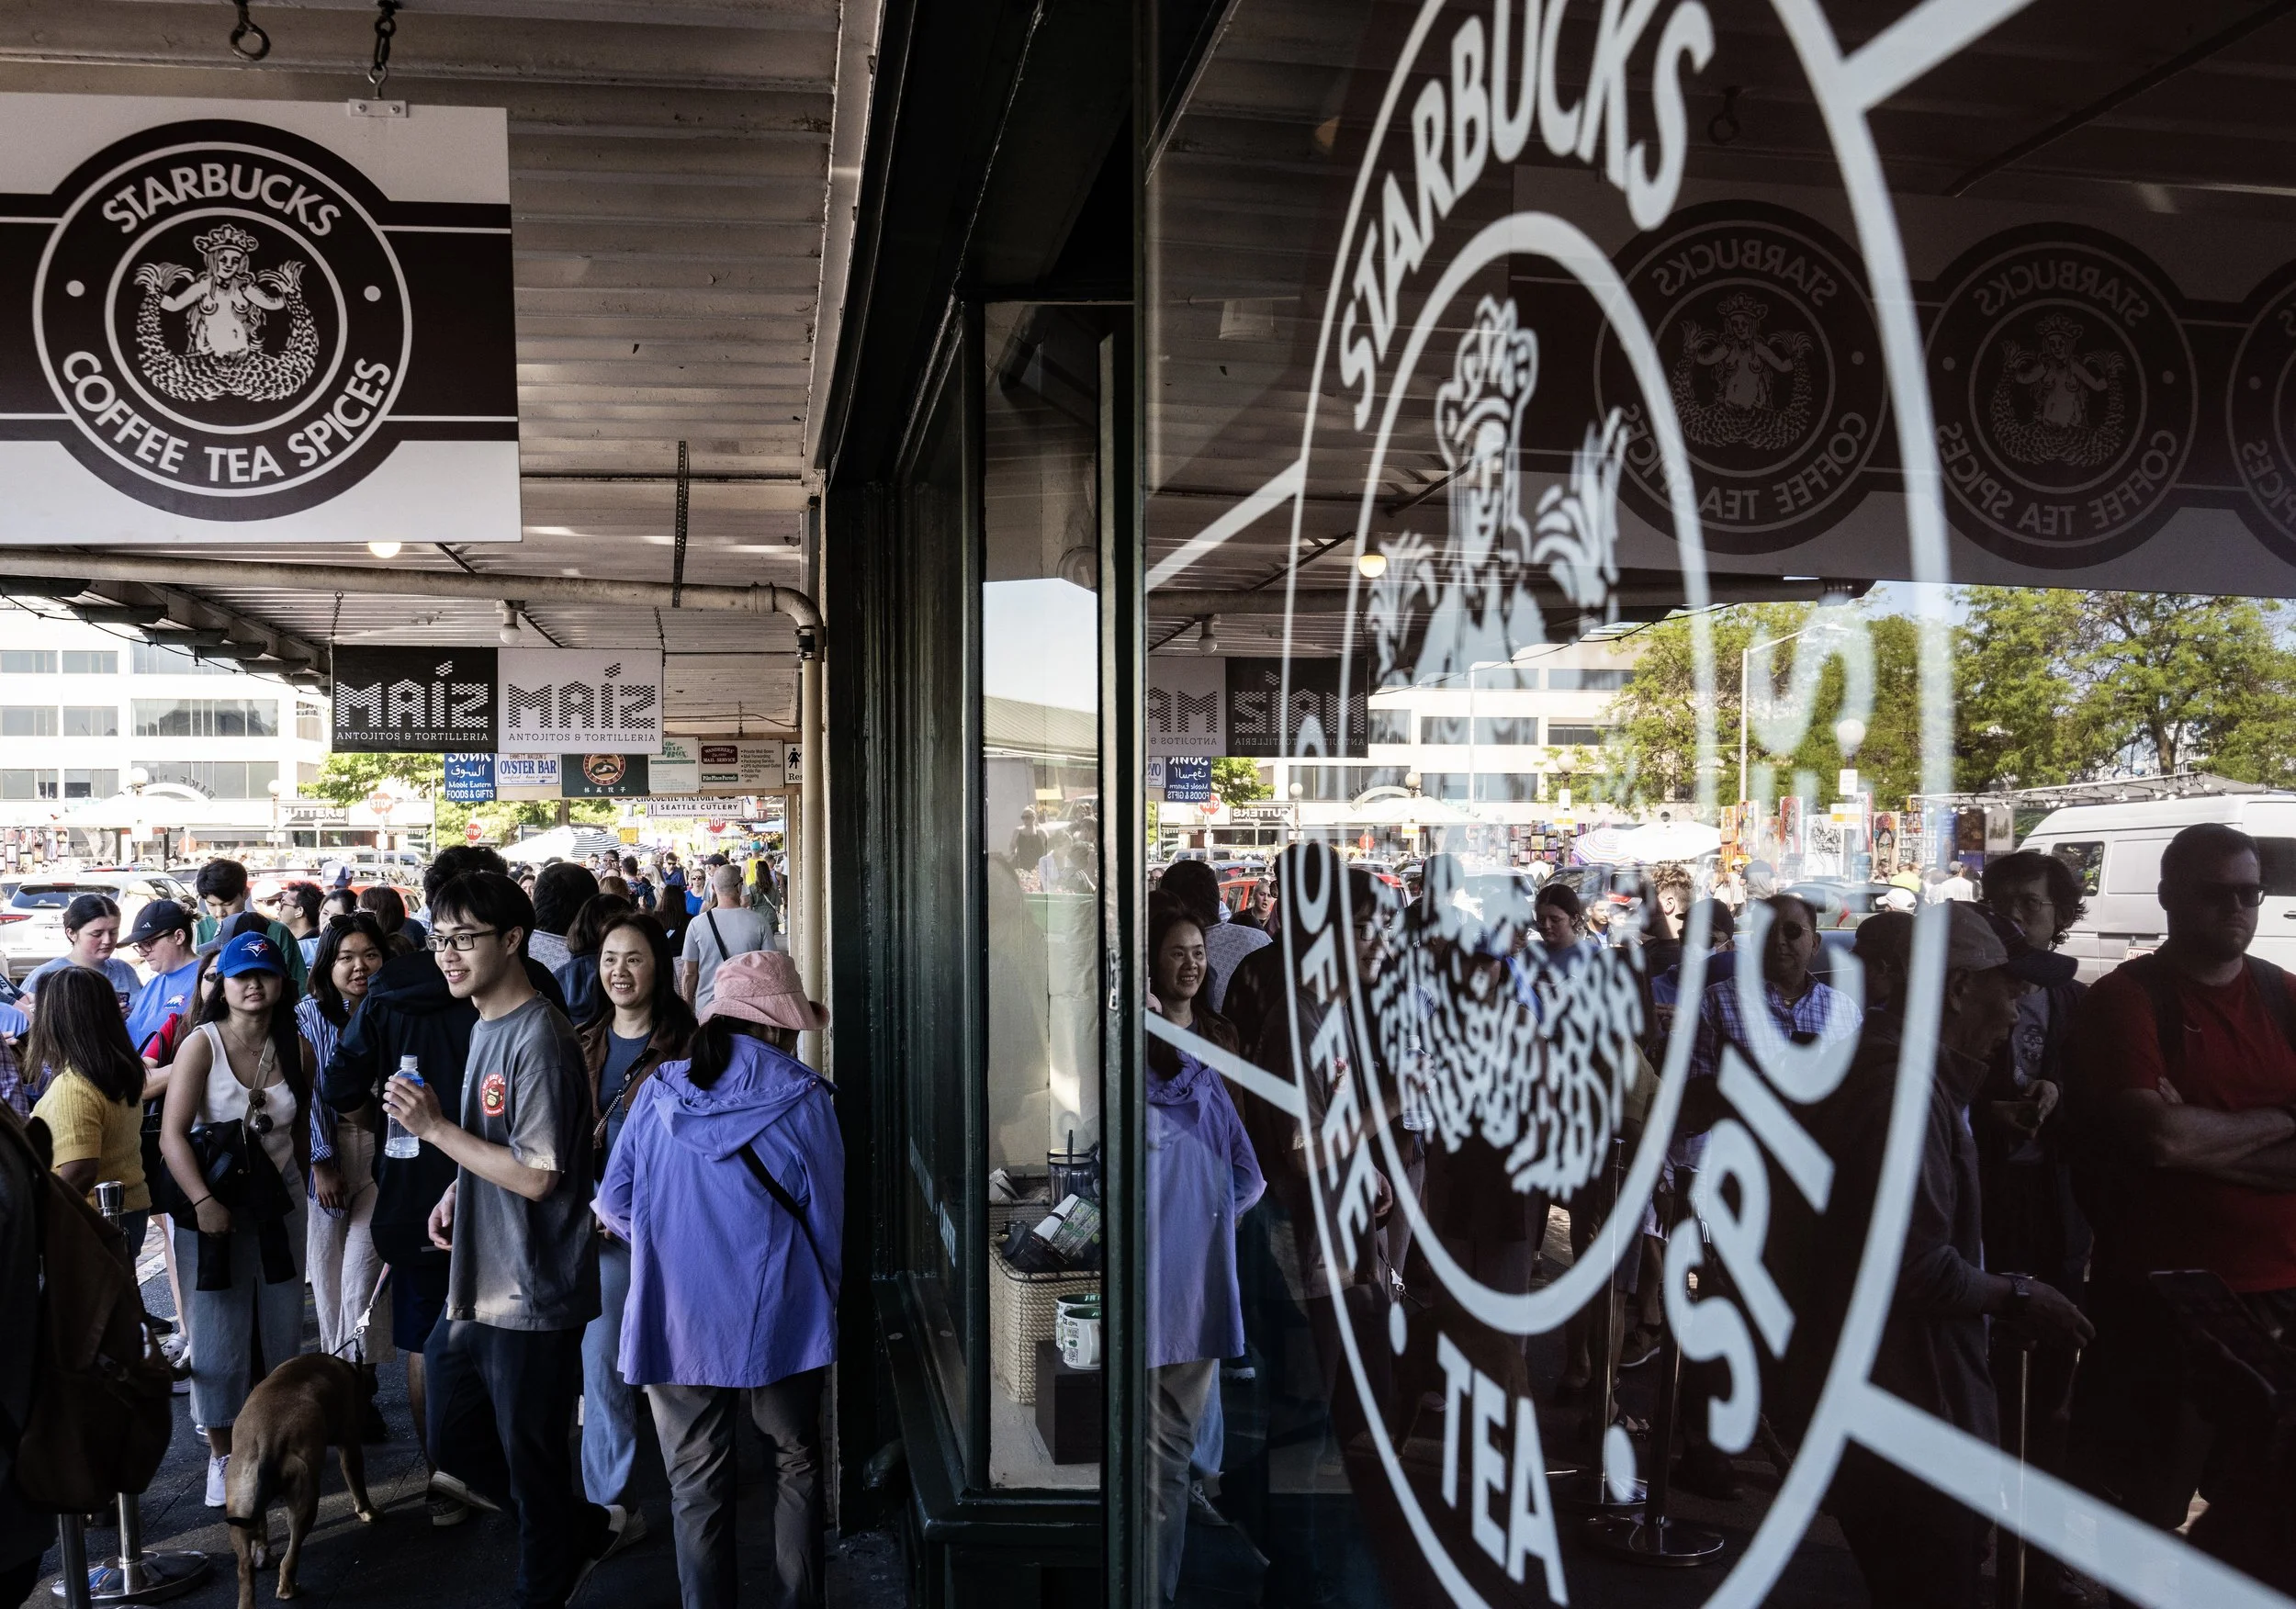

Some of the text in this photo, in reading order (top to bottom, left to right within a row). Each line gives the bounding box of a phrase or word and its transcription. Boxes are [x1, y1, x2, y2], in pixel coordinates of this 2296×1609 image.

[102, 163, 343, 237] STARBUCKS
[1339, 0, 1715, 432] STARBUCKS
[62, 351, 391, 483] COFFEE TEA SPICES
[336, 660, 489, 728] MAÍZ
[508, 663, 656, 729] MAÍZ
[336, 732, 489, 741] ANTOJITOS & TORTILLERIA
[509, 733, 656, 742] ANTOJITOS & TORTILLERIA
[500, 760, 557, 774] OYSTER BAR
[370, 798, 393, 809] STOP
[446, 790, 494, 798] FOODS & GIFTS
[709, 818, 725, 827] TOP
[1435, 1331, 1570, 1607] TEA
[1664, 593, 1877, 1455] SPICS
